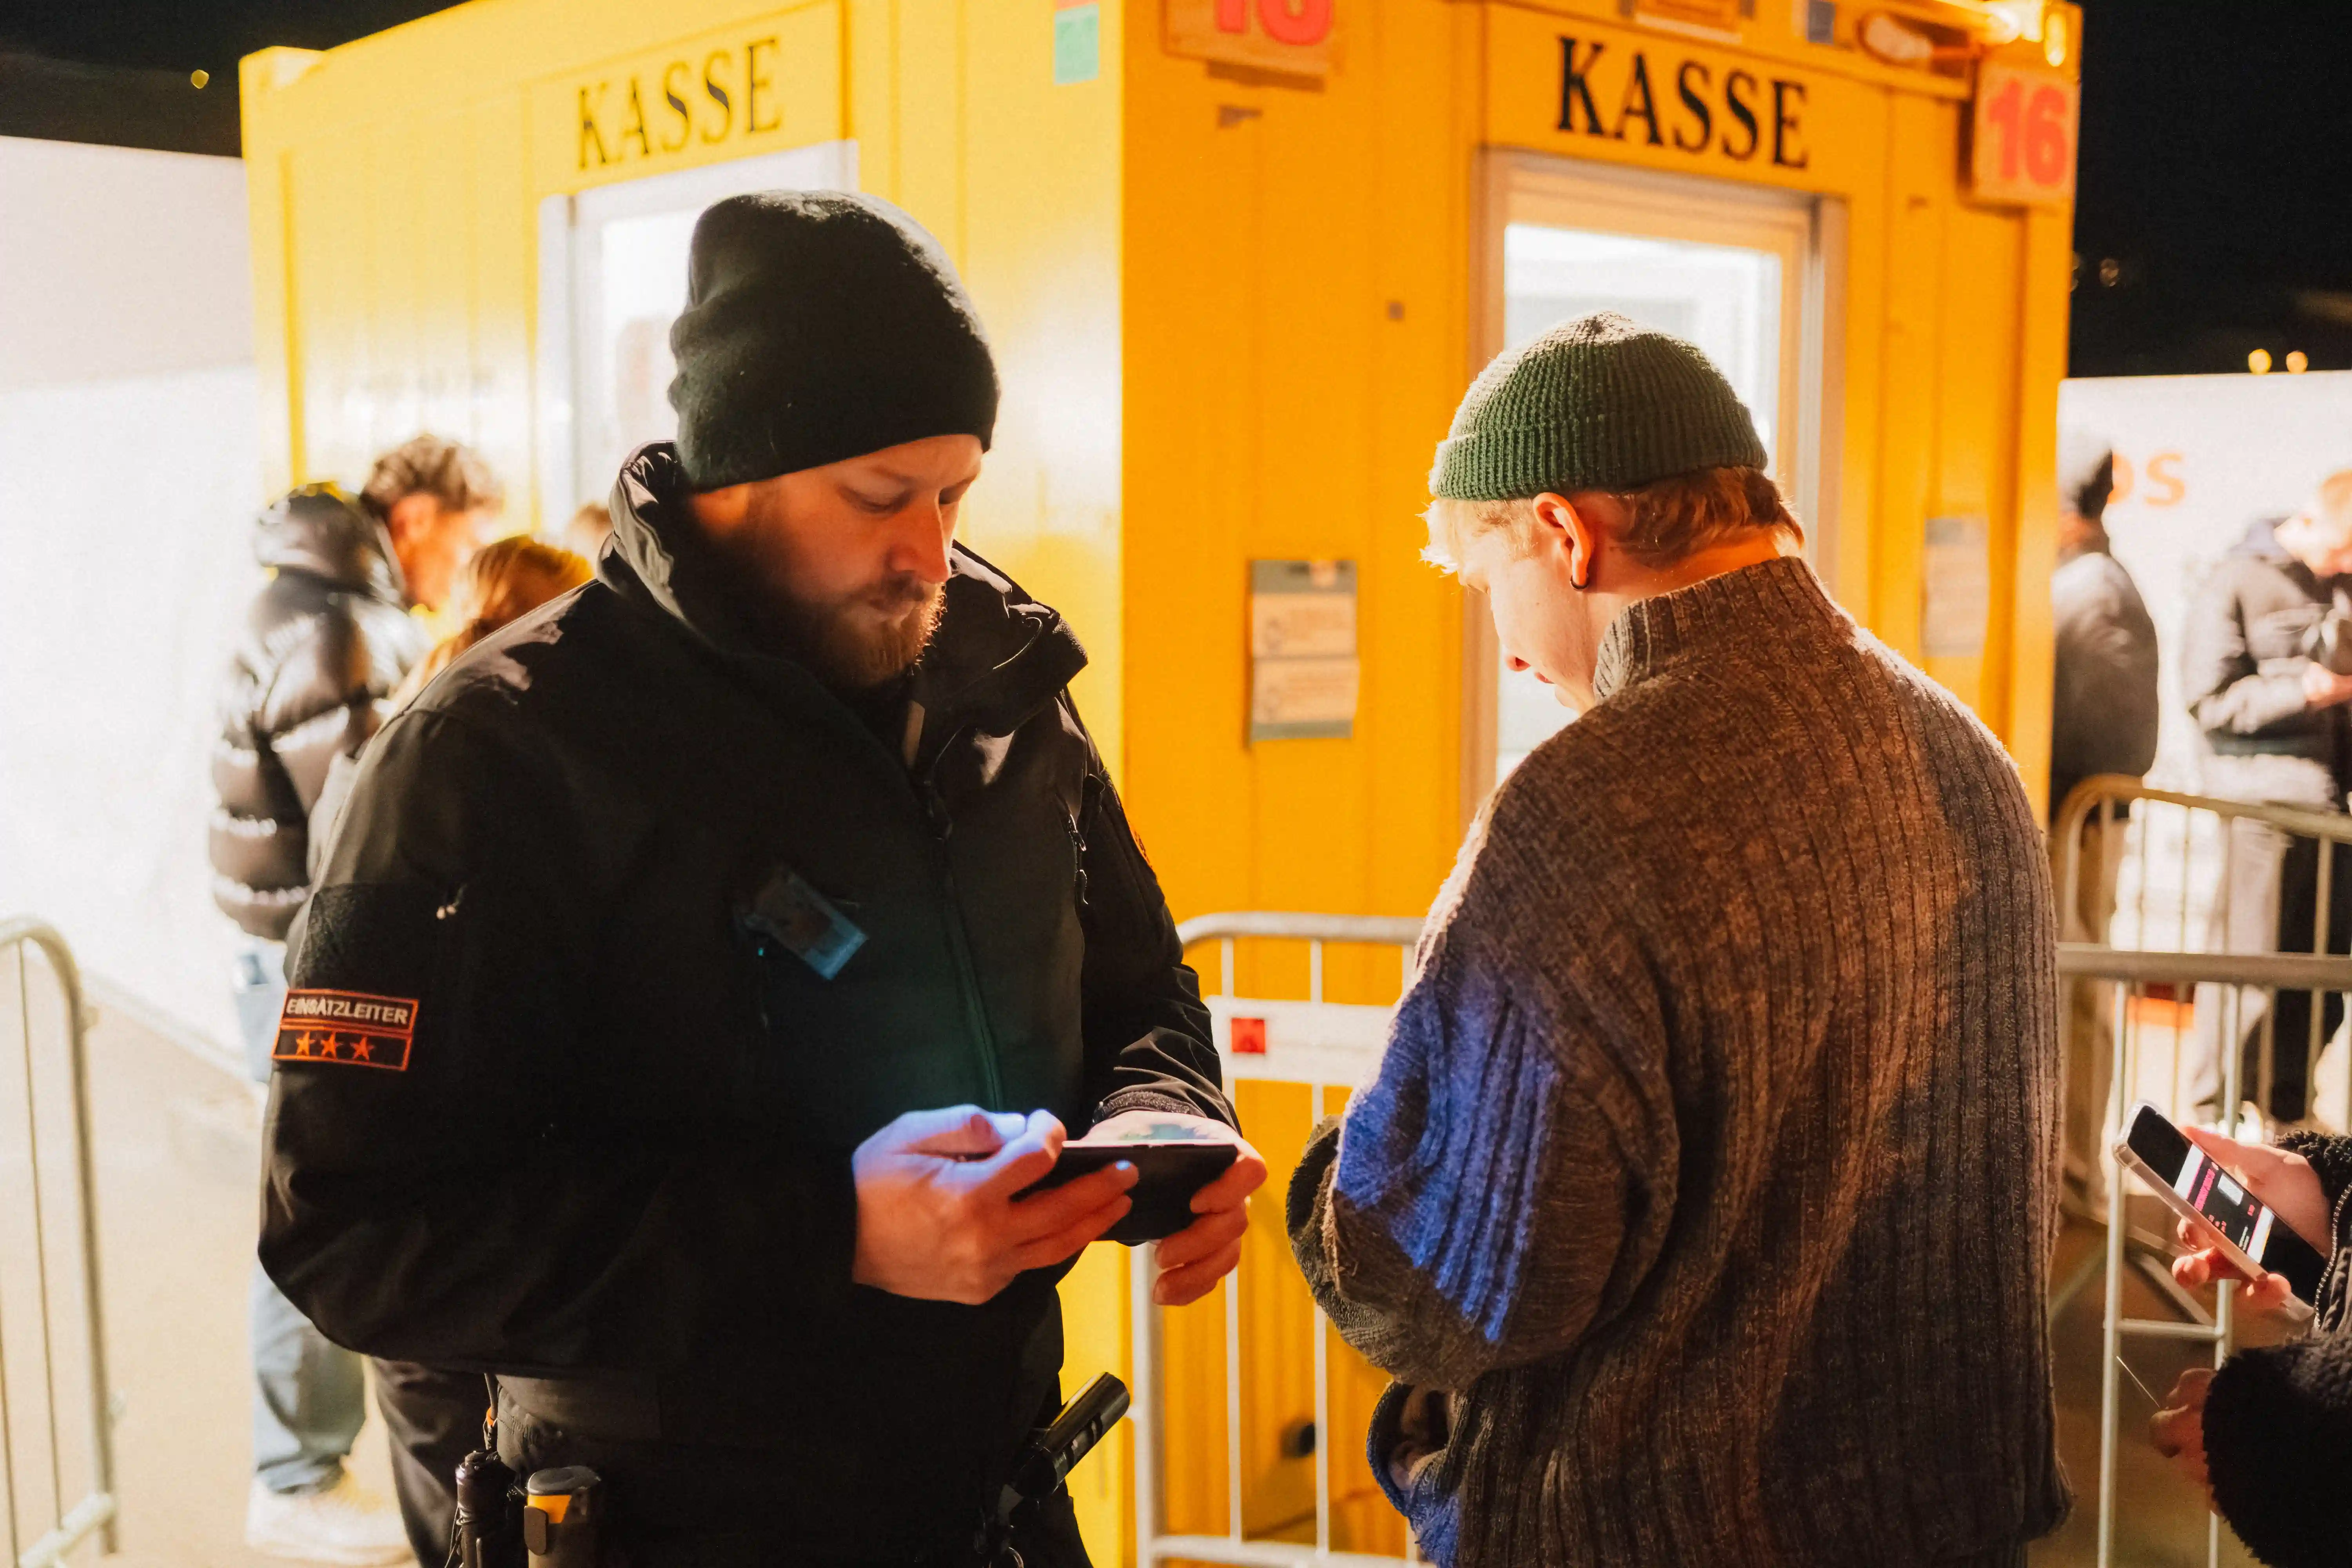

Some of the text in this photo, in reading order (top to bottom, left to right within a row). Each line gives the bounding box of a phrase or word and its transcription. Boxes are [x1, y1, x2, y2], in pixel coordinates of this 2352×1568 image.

[578, 38, 780, 169] KASSE
[1557, 36, 1808, 169] KASSE
[1989, 78, 2068, 185] 16
[287, 997, 408, 1024] EINSATZLEITER
